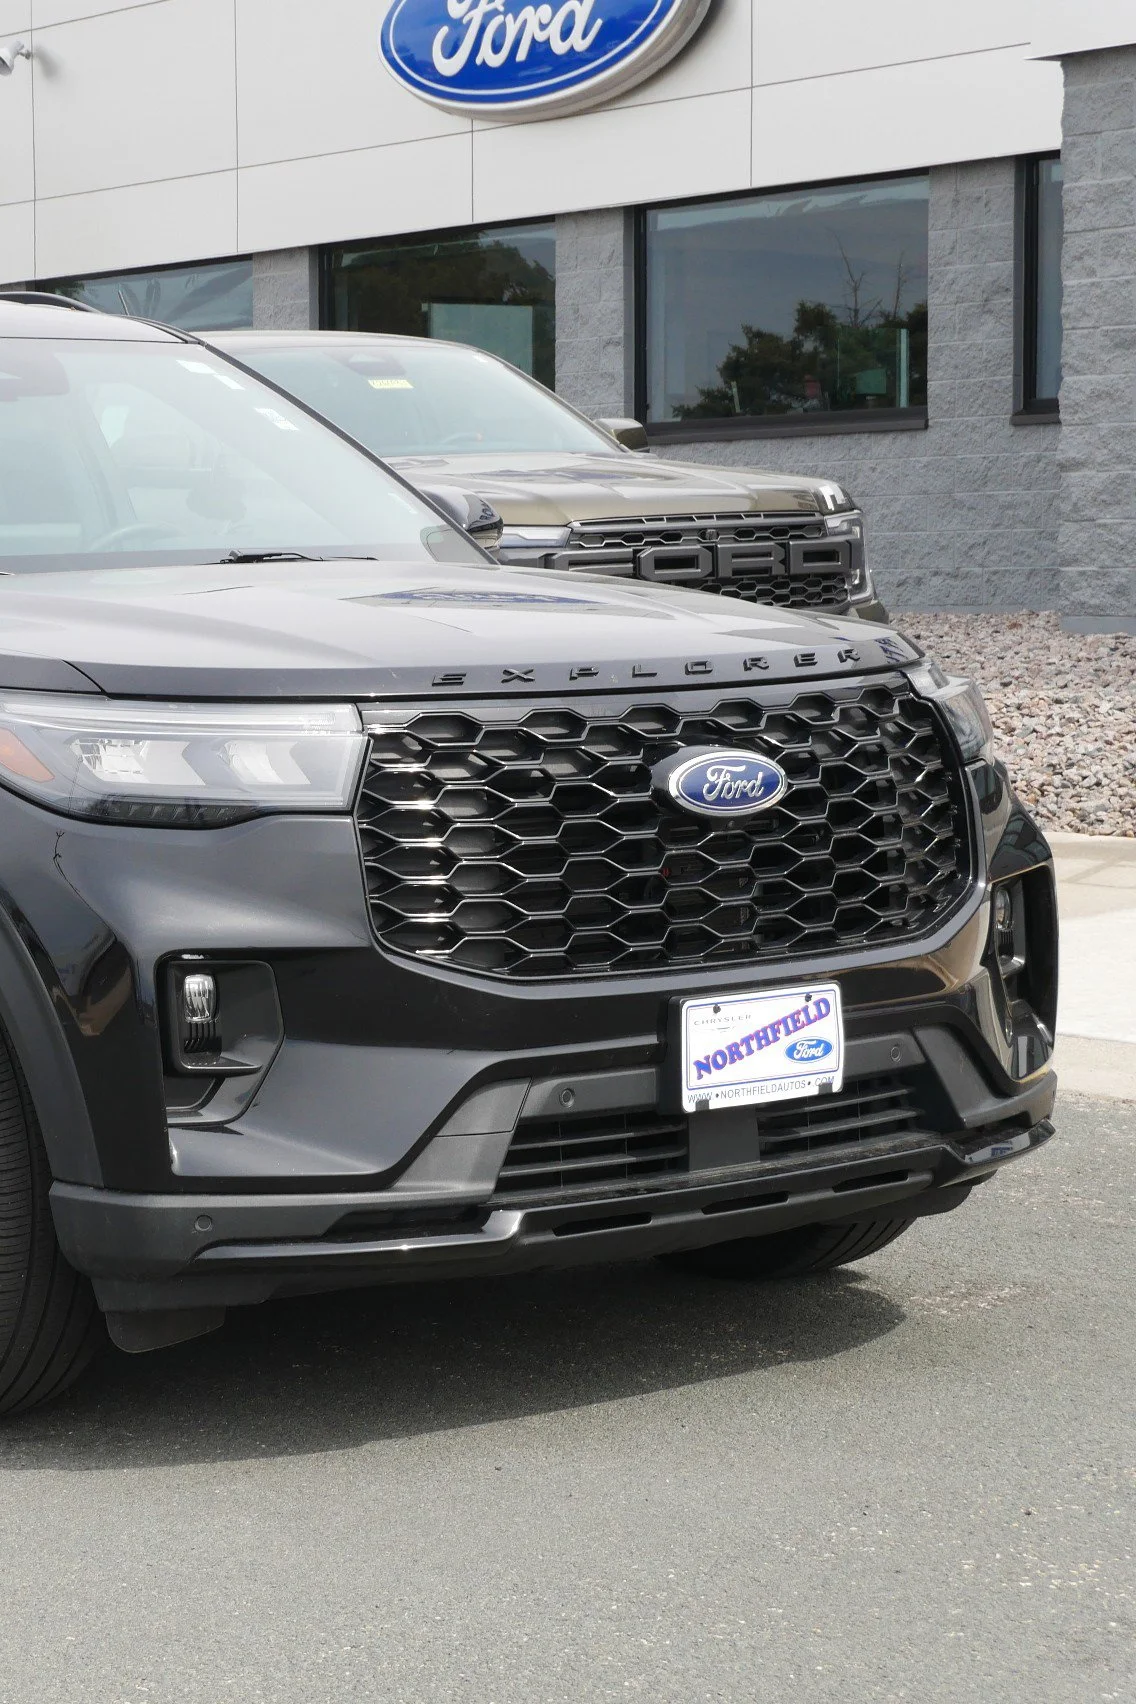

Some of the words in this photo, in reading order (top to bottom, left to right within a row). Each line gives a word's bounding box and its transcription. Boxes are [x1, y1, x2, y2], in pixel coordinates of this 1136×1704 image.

[431, 0, 603, 78] Ford
[431, 648, 861, 687] EXPLORER
[703, 764, 767, 802] Ford
[693, 1013, 753, 1026] CHRYSLER
[692, 997, 831, 1081] NORTHFIELD
[793, 1039, 826, 1060] Ford
